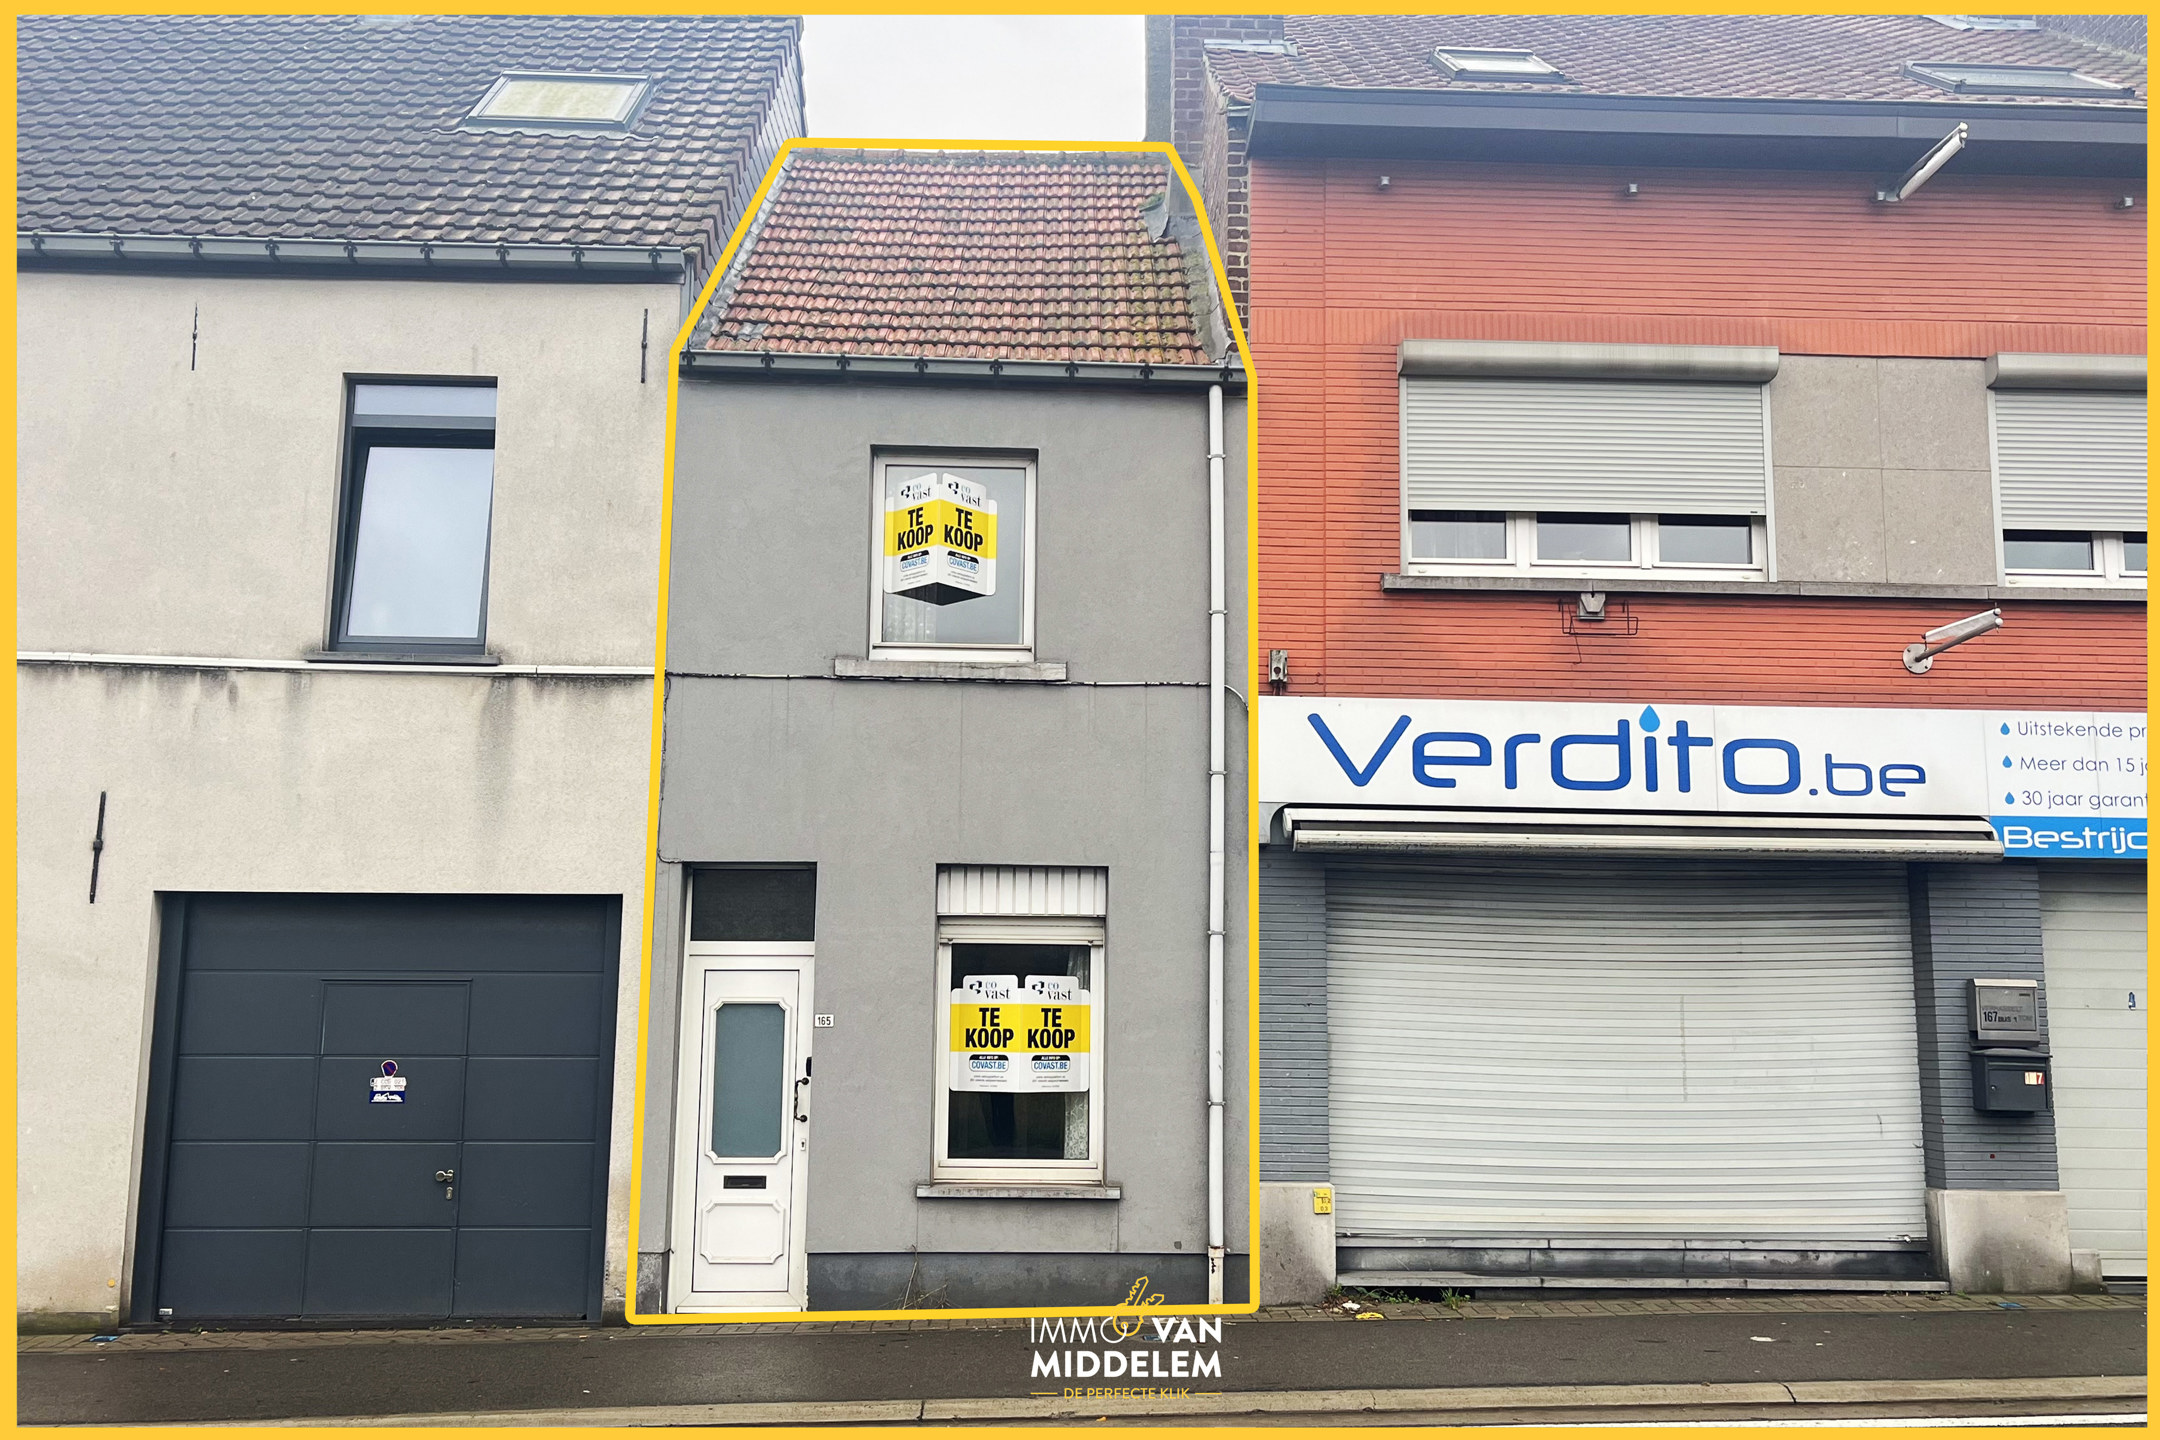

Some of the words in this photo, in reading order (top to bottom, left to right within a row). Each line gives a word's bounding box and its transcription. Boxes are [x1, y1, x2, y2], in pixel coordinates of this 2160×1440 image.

[912, 487, 932, 501] vast
[960, 493, 982, 508] vast
[907, 506, 924, 529] TE
[955, 507, 973, 531] TE
[897, 524, 934, 552] KOOP
[944, 524, 984, 552] KOOP
[2017, 720, 2123, 738] Uitstekende
[1307, 705, 1927, 797] Verdito.be
[2020, 756, 2067, 771] Meer
[2072, 757, 2109, 772] dan
[2116, 757, 2135, 773] 15
[2140, 757, 2147, 776] j
[2022, 790, 2043, 806] 30
[2047, 790, 2083, 809] jaar
[985, 981, 997, 989] co
[985, 988, 1011, 1000] vast
[1047, 982, 1059, 991] co
[1047, 989, 1072, 1001] vast
[817, 1016, 831, 1026] 165
[979, 1007, 1000, 1027] TE
[1041, 1008, 1062, 1028] TE
[1983, 1011, 1998, 1023] 167
[965, 1028, 1014, 1048] KOOP
[1027, 1028, 1076, 1049] KOOP
[971, 1060, 1006, 1070] COVAST.BE
[1034, 1061, 1068, 1070] COVAST.BE
